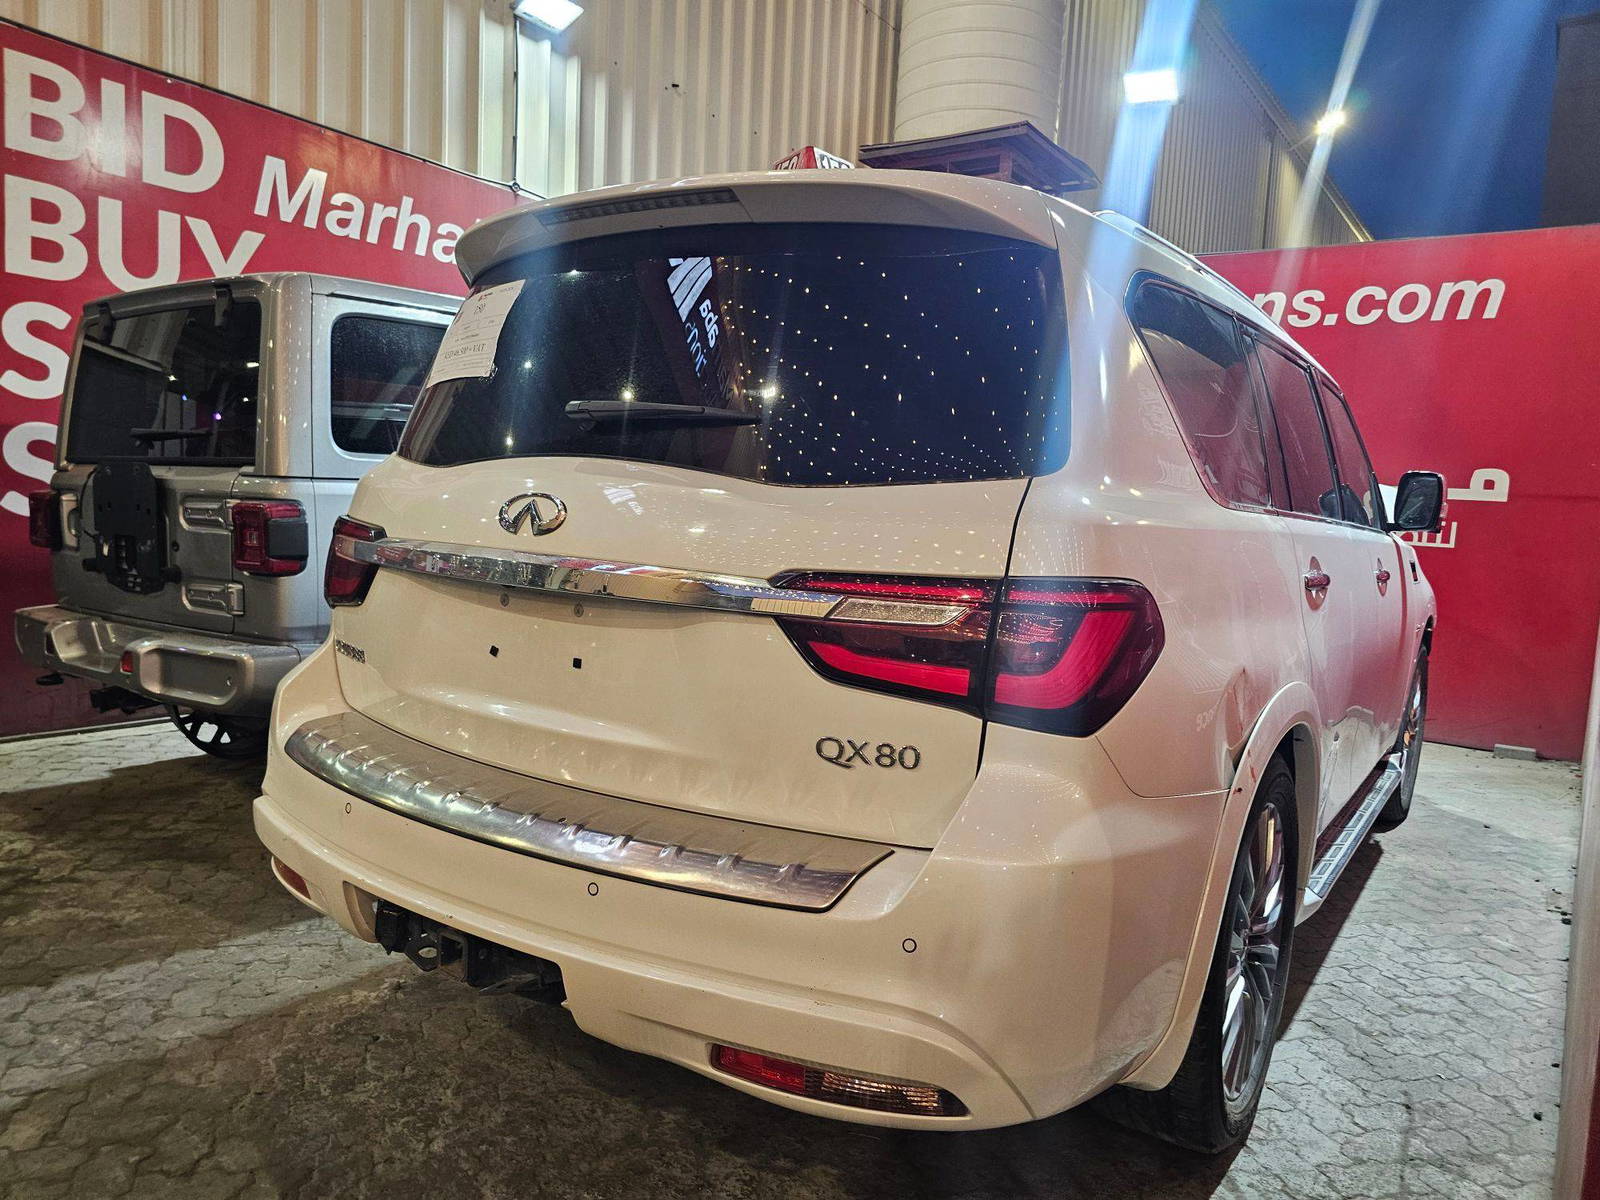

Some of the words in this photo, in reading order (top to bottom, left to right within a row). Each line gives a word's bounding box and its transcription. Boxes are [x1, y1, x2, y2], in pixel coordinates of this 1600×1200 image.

[2, 47, 225, 194] BID
[3, 174, 265, 293] BUY
[254, 154, 467, 266] Marha
[1252, 277, 1506, 328] ns.com
[815, 736, 921, 770] QX80
